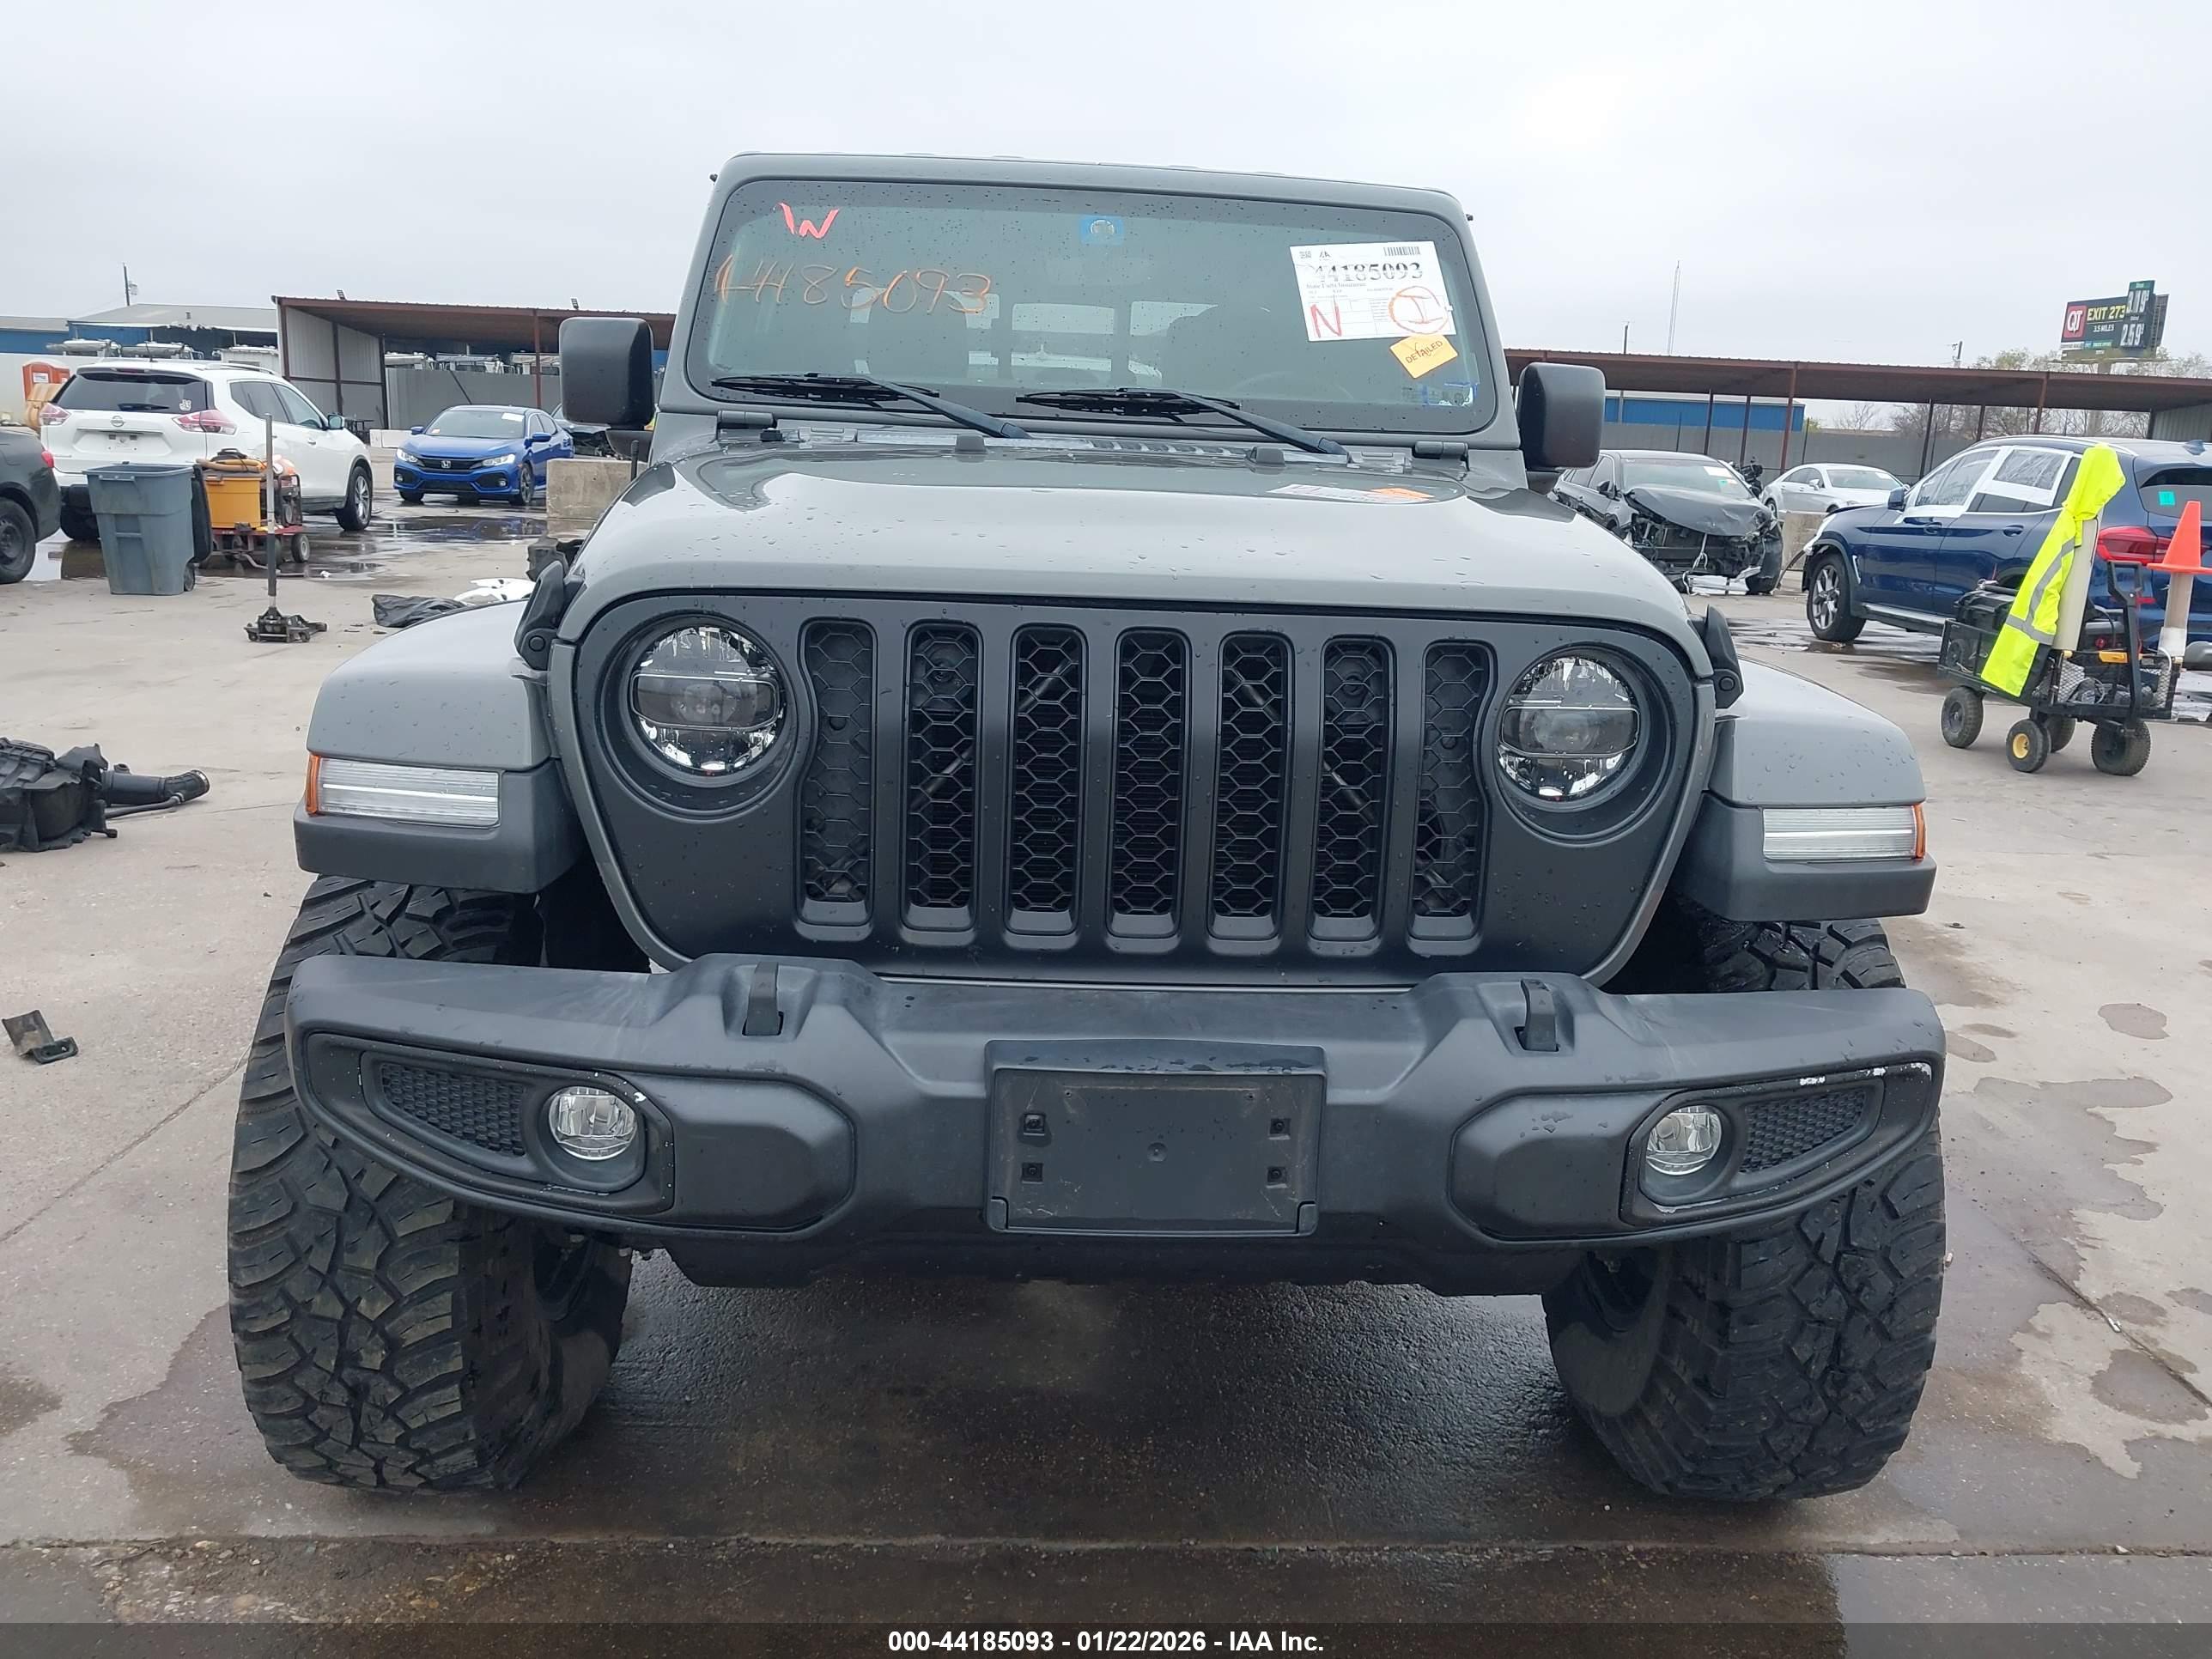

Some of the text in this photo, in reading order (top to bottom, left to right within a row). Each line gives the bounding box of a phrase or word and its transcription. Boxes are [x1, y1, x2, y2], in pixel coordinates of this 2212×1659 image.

[2067, 310, 2083, 334] QT
[2087, 305, 2126, 322] EXIT 273
[1405, 340, 1443, 364] DETAILED
